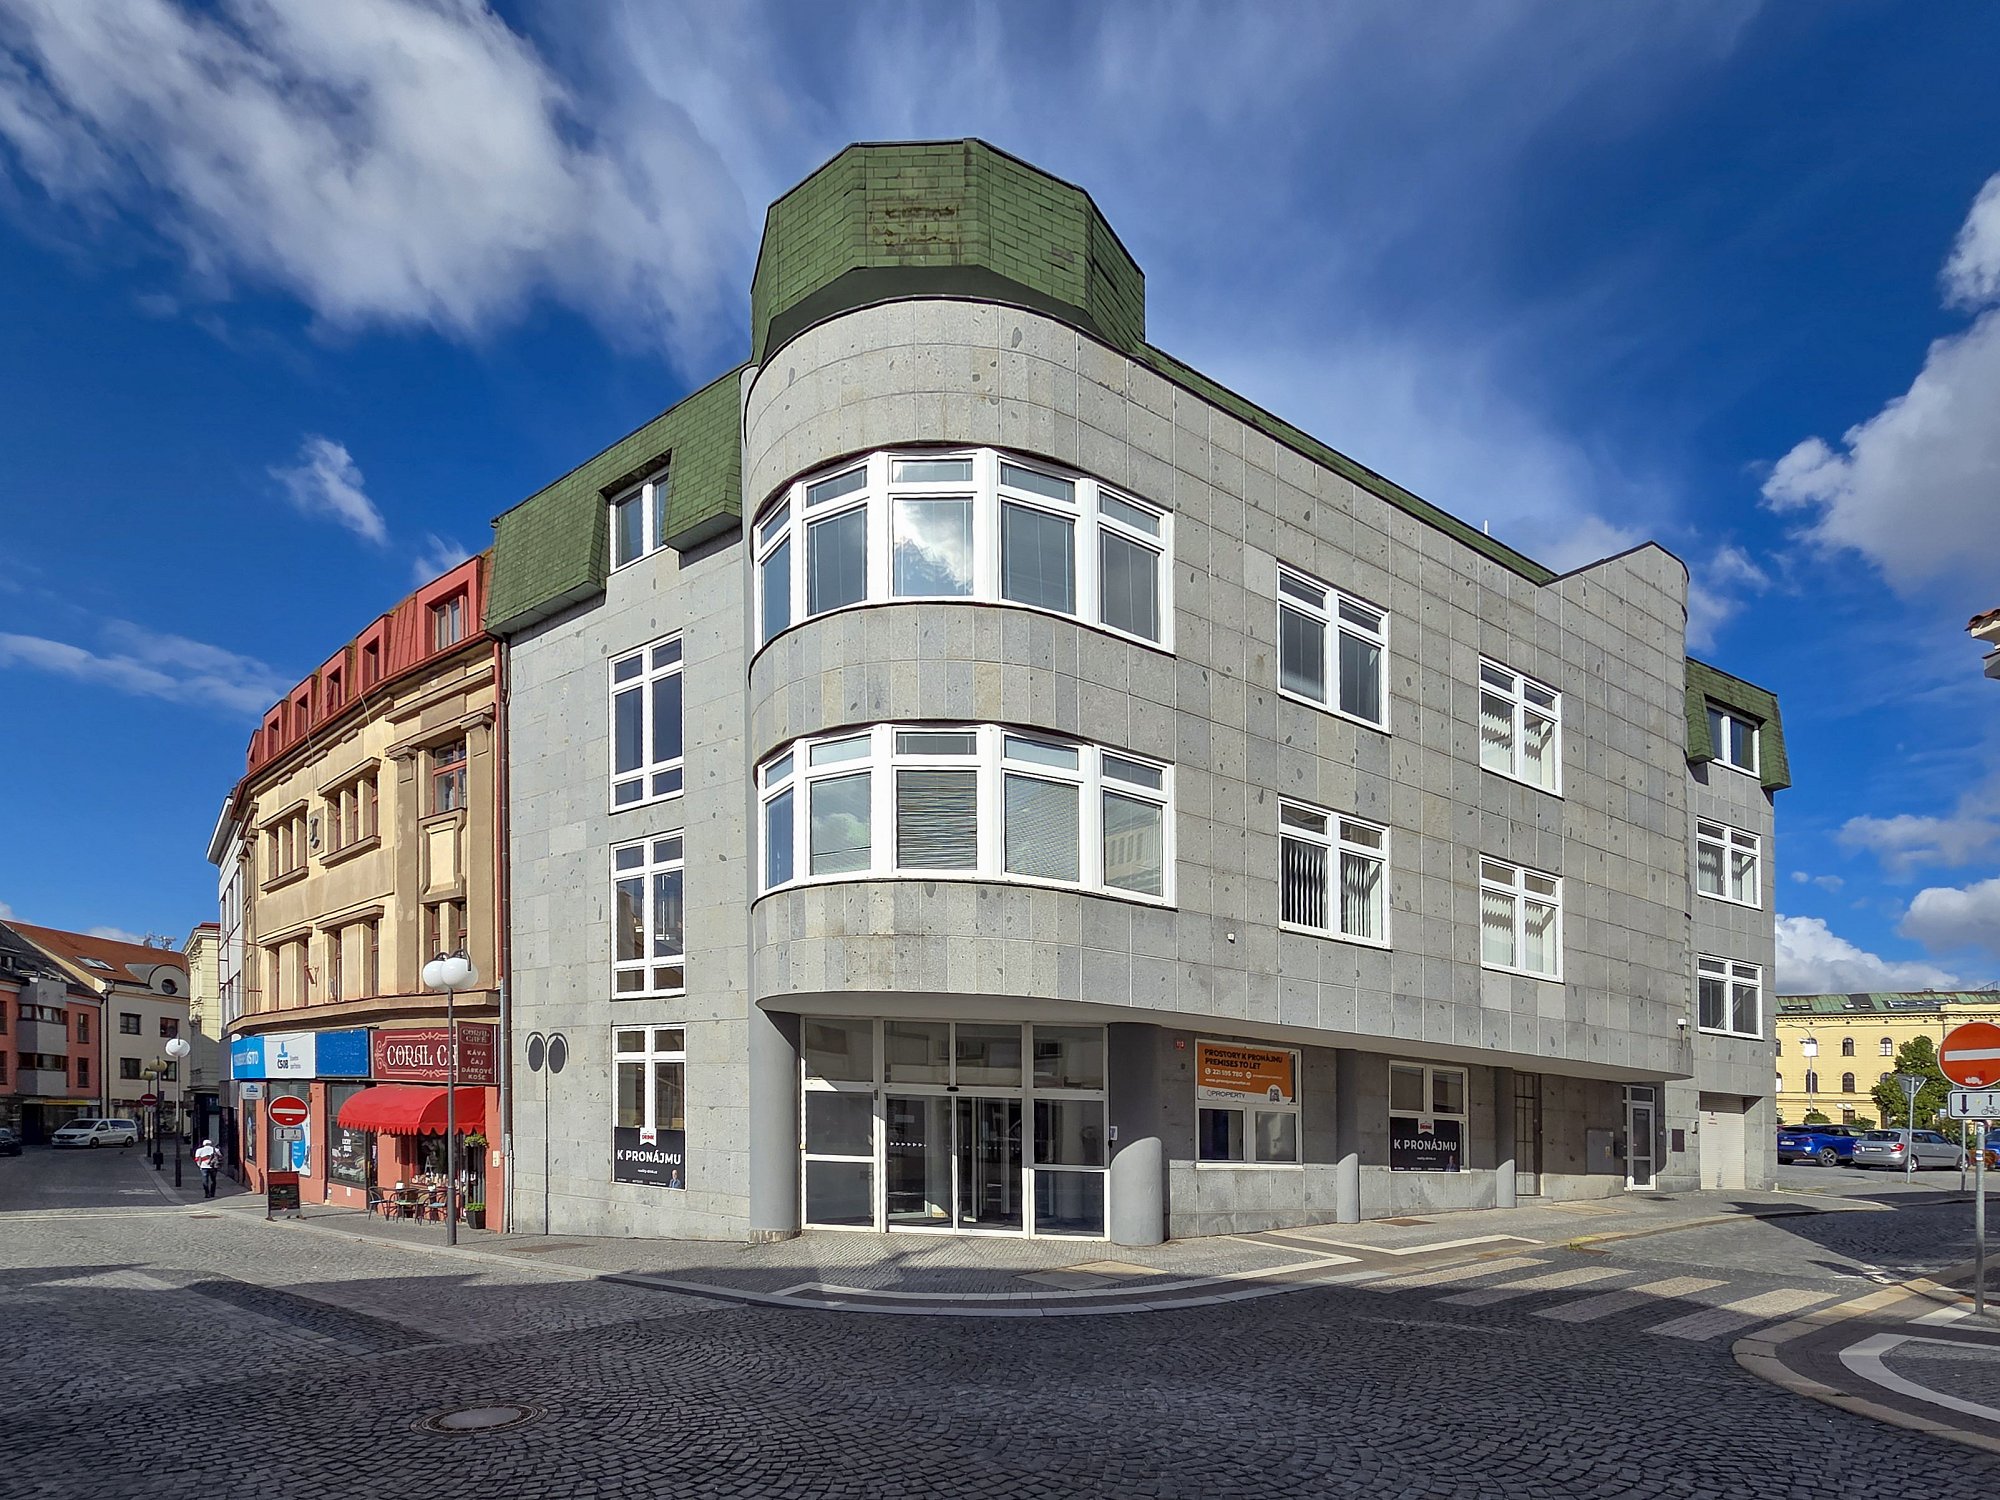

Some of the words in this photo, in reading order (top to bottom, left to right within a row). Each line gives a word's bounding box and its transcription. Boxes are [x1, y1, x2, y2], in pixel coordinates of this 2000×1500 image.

[387, 1045, 433, 1067] CORAL
[467, 1049, 487, 1057] KÁVA
[1204, 1048, 1241, 1060] PROSTORY
[1247, 1053, 1283, 1064] PRONÁJMU
[470, 1057, 484, 1066] ČAJ
[1204, 1057, 1238, 1068] PREMISES
[1239, 1061, 1249, 1069] TO
[1249, 1062, 1261, 1070] LET
[461, 1066, 493, 1075] DÁRKOVÉ
[468, 1073, 486, 1081] KOŠE
[1394, 1138, 1401, 1150] K
[1404, 1138, 1457, 1151] PRONÁJMU
[617, 1149, 624, 1160] K
[625, 1149, 681, 1165] PRONÁJMU
